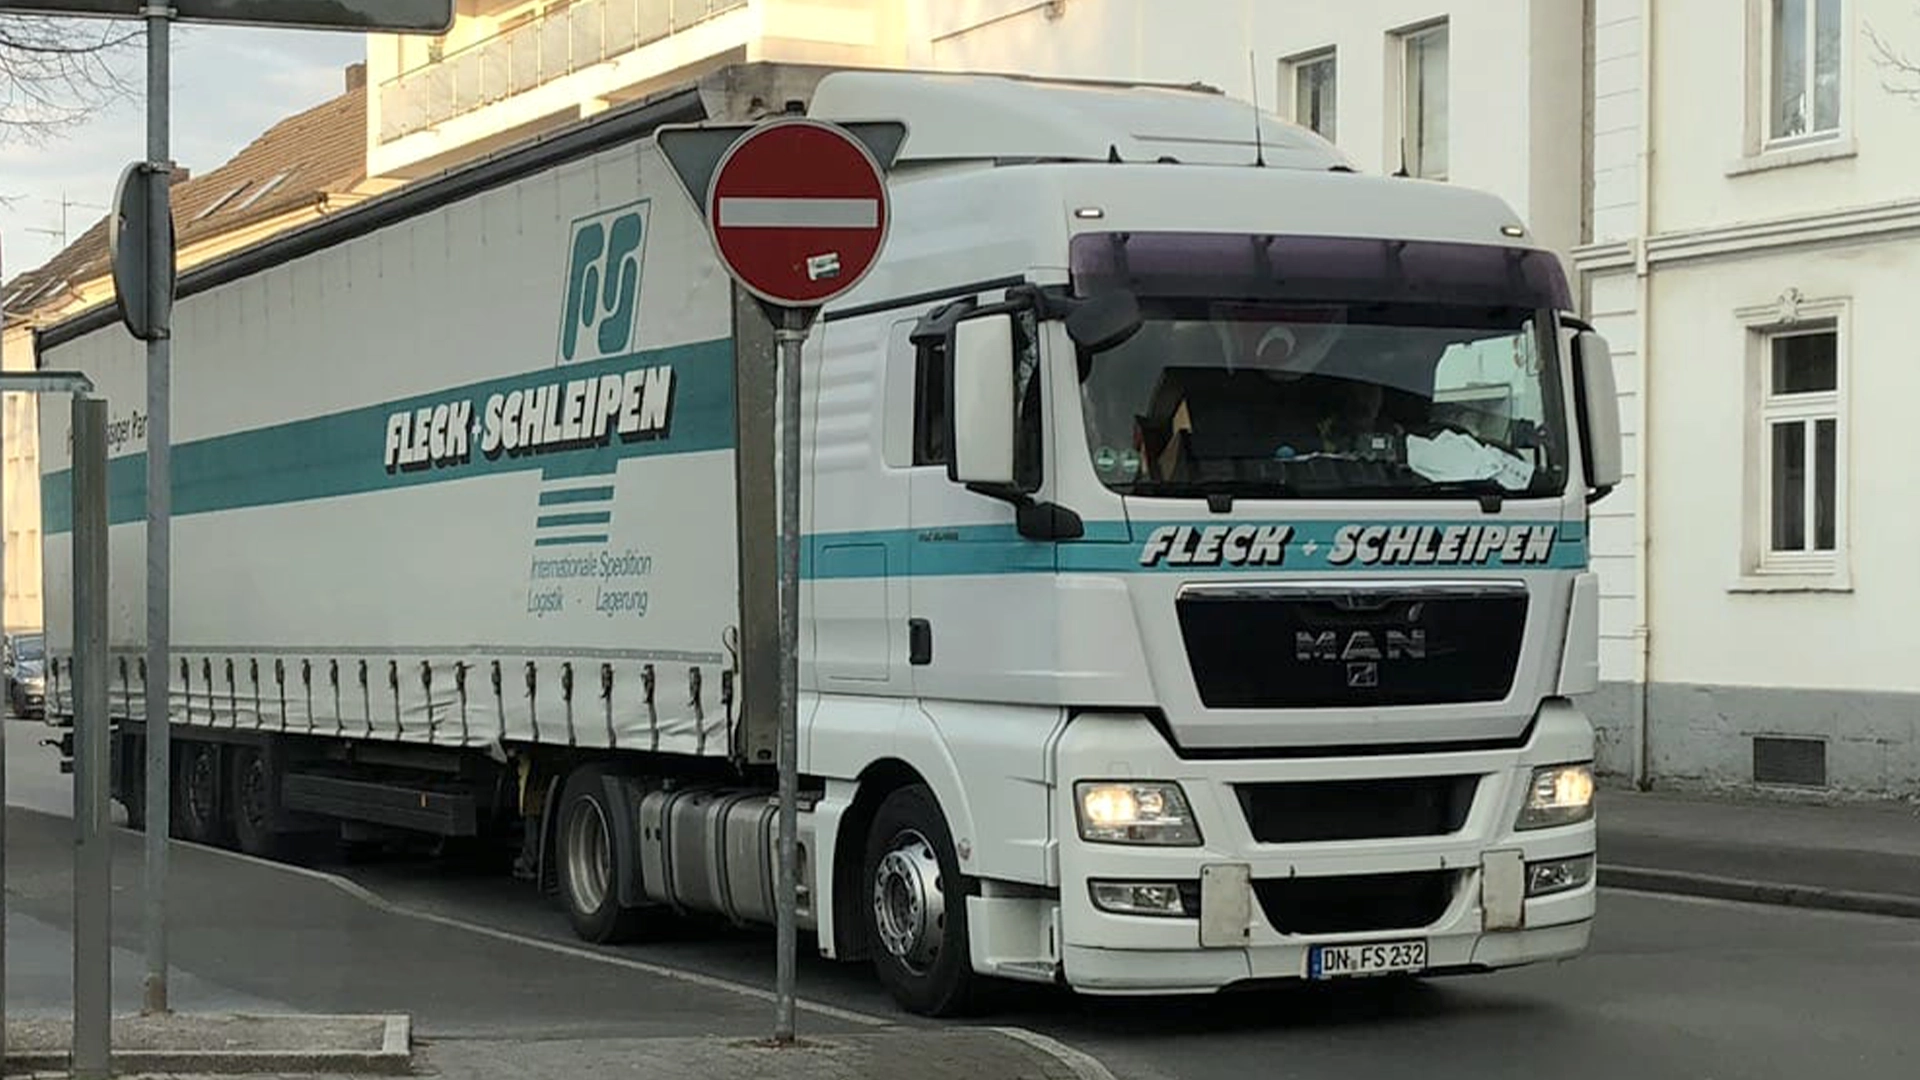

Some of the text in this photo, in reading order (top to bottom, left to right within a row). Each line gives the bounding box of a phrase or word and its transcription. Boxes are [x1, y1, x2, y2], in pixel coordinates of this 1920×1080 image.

[384, 399, 473, 475] FLECK
[481, 365, 675, 461] SCHLEIPEN
[1139, 524, 1557, 566] FLECK + SCHLEIPEN
[531, 549, 652, 582] Internationale Spedition
[527, 586, 563, 617] Logistik
[596, 586, 648, 617] Lagerung
[1295, 629, 1426, 660] MAN
[1324, 949, 1350, 971] DN
[1361, 947, 1386, 968] FS
[1390, 944, 1424, 967] 232
